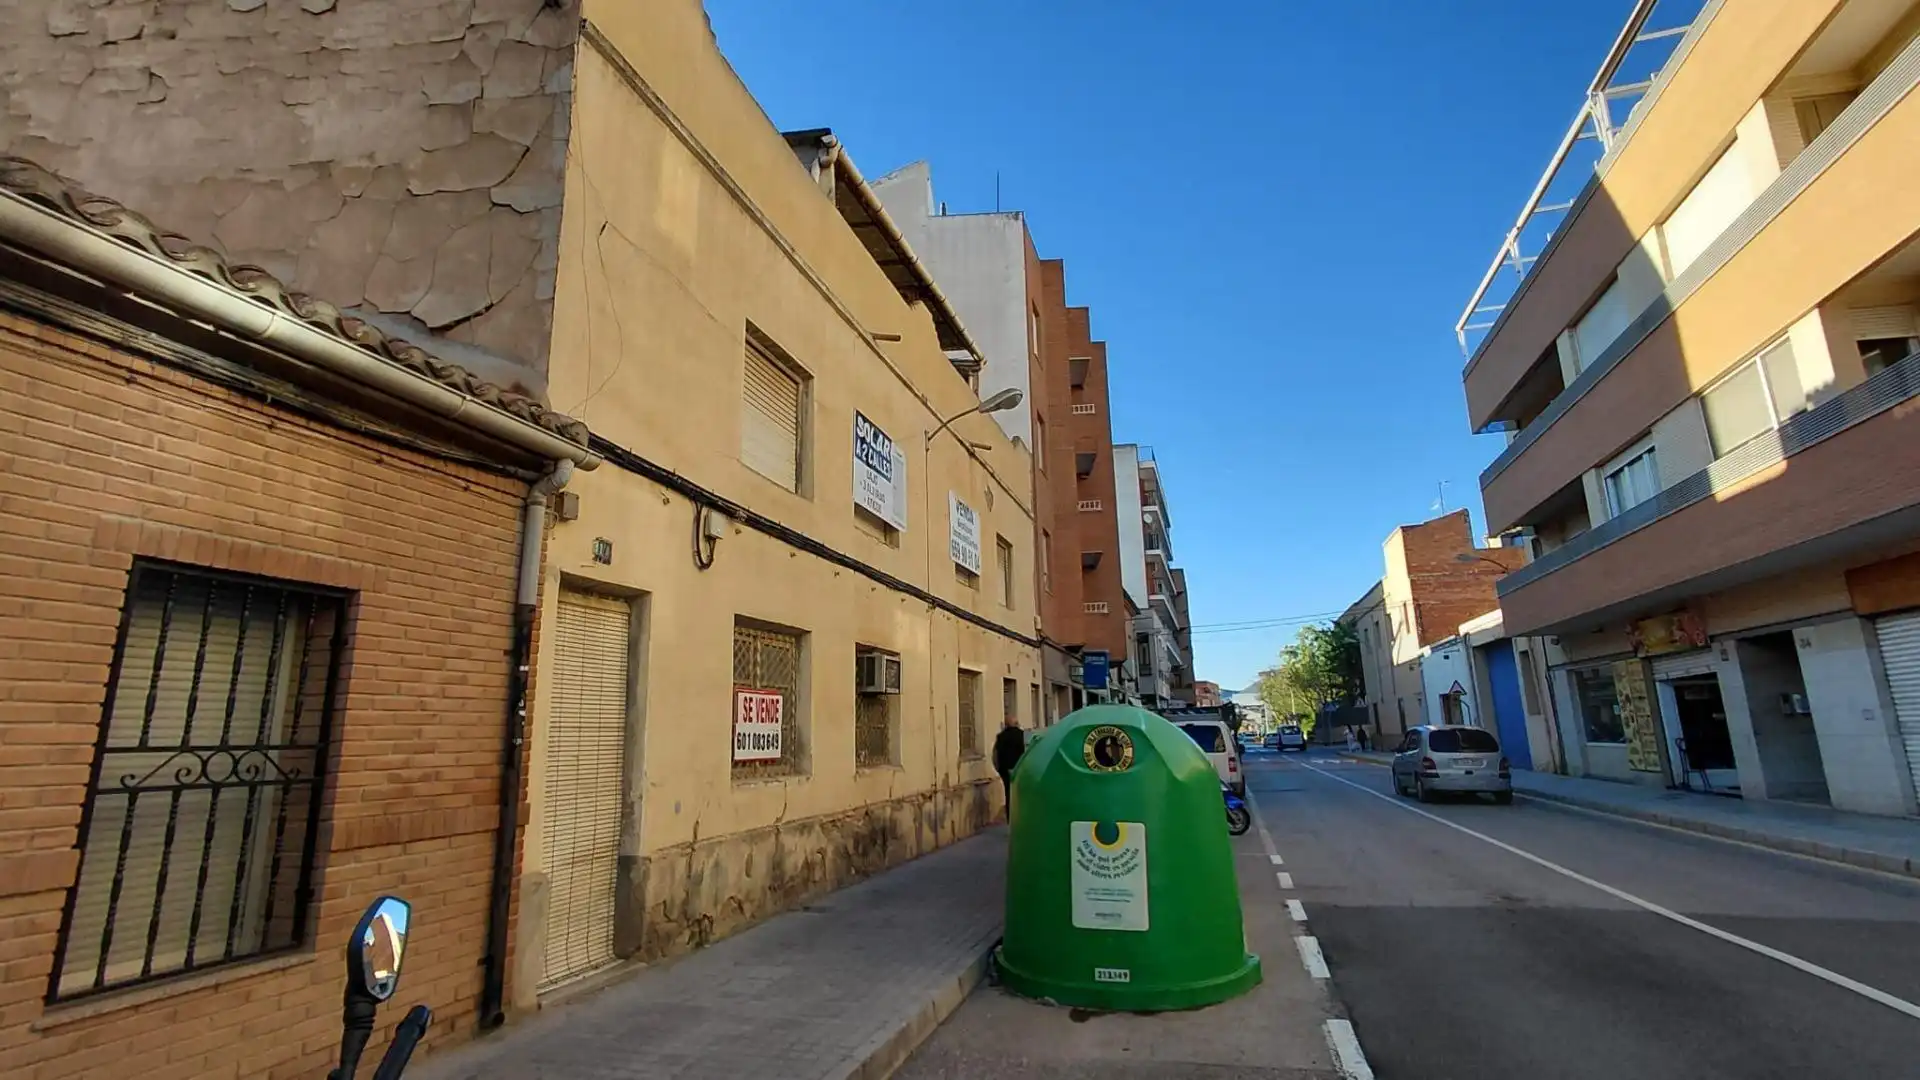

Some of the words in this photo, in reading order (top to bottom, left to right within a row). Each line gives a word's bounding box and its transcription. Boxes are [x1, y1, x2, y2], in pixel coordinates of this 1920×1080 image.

[857, 416, 891, 460] SOLAR
[862, 444, 868, 461] 2
[743, 696, 753, 723] SE
[756, 697, 779, 723] VENDE
